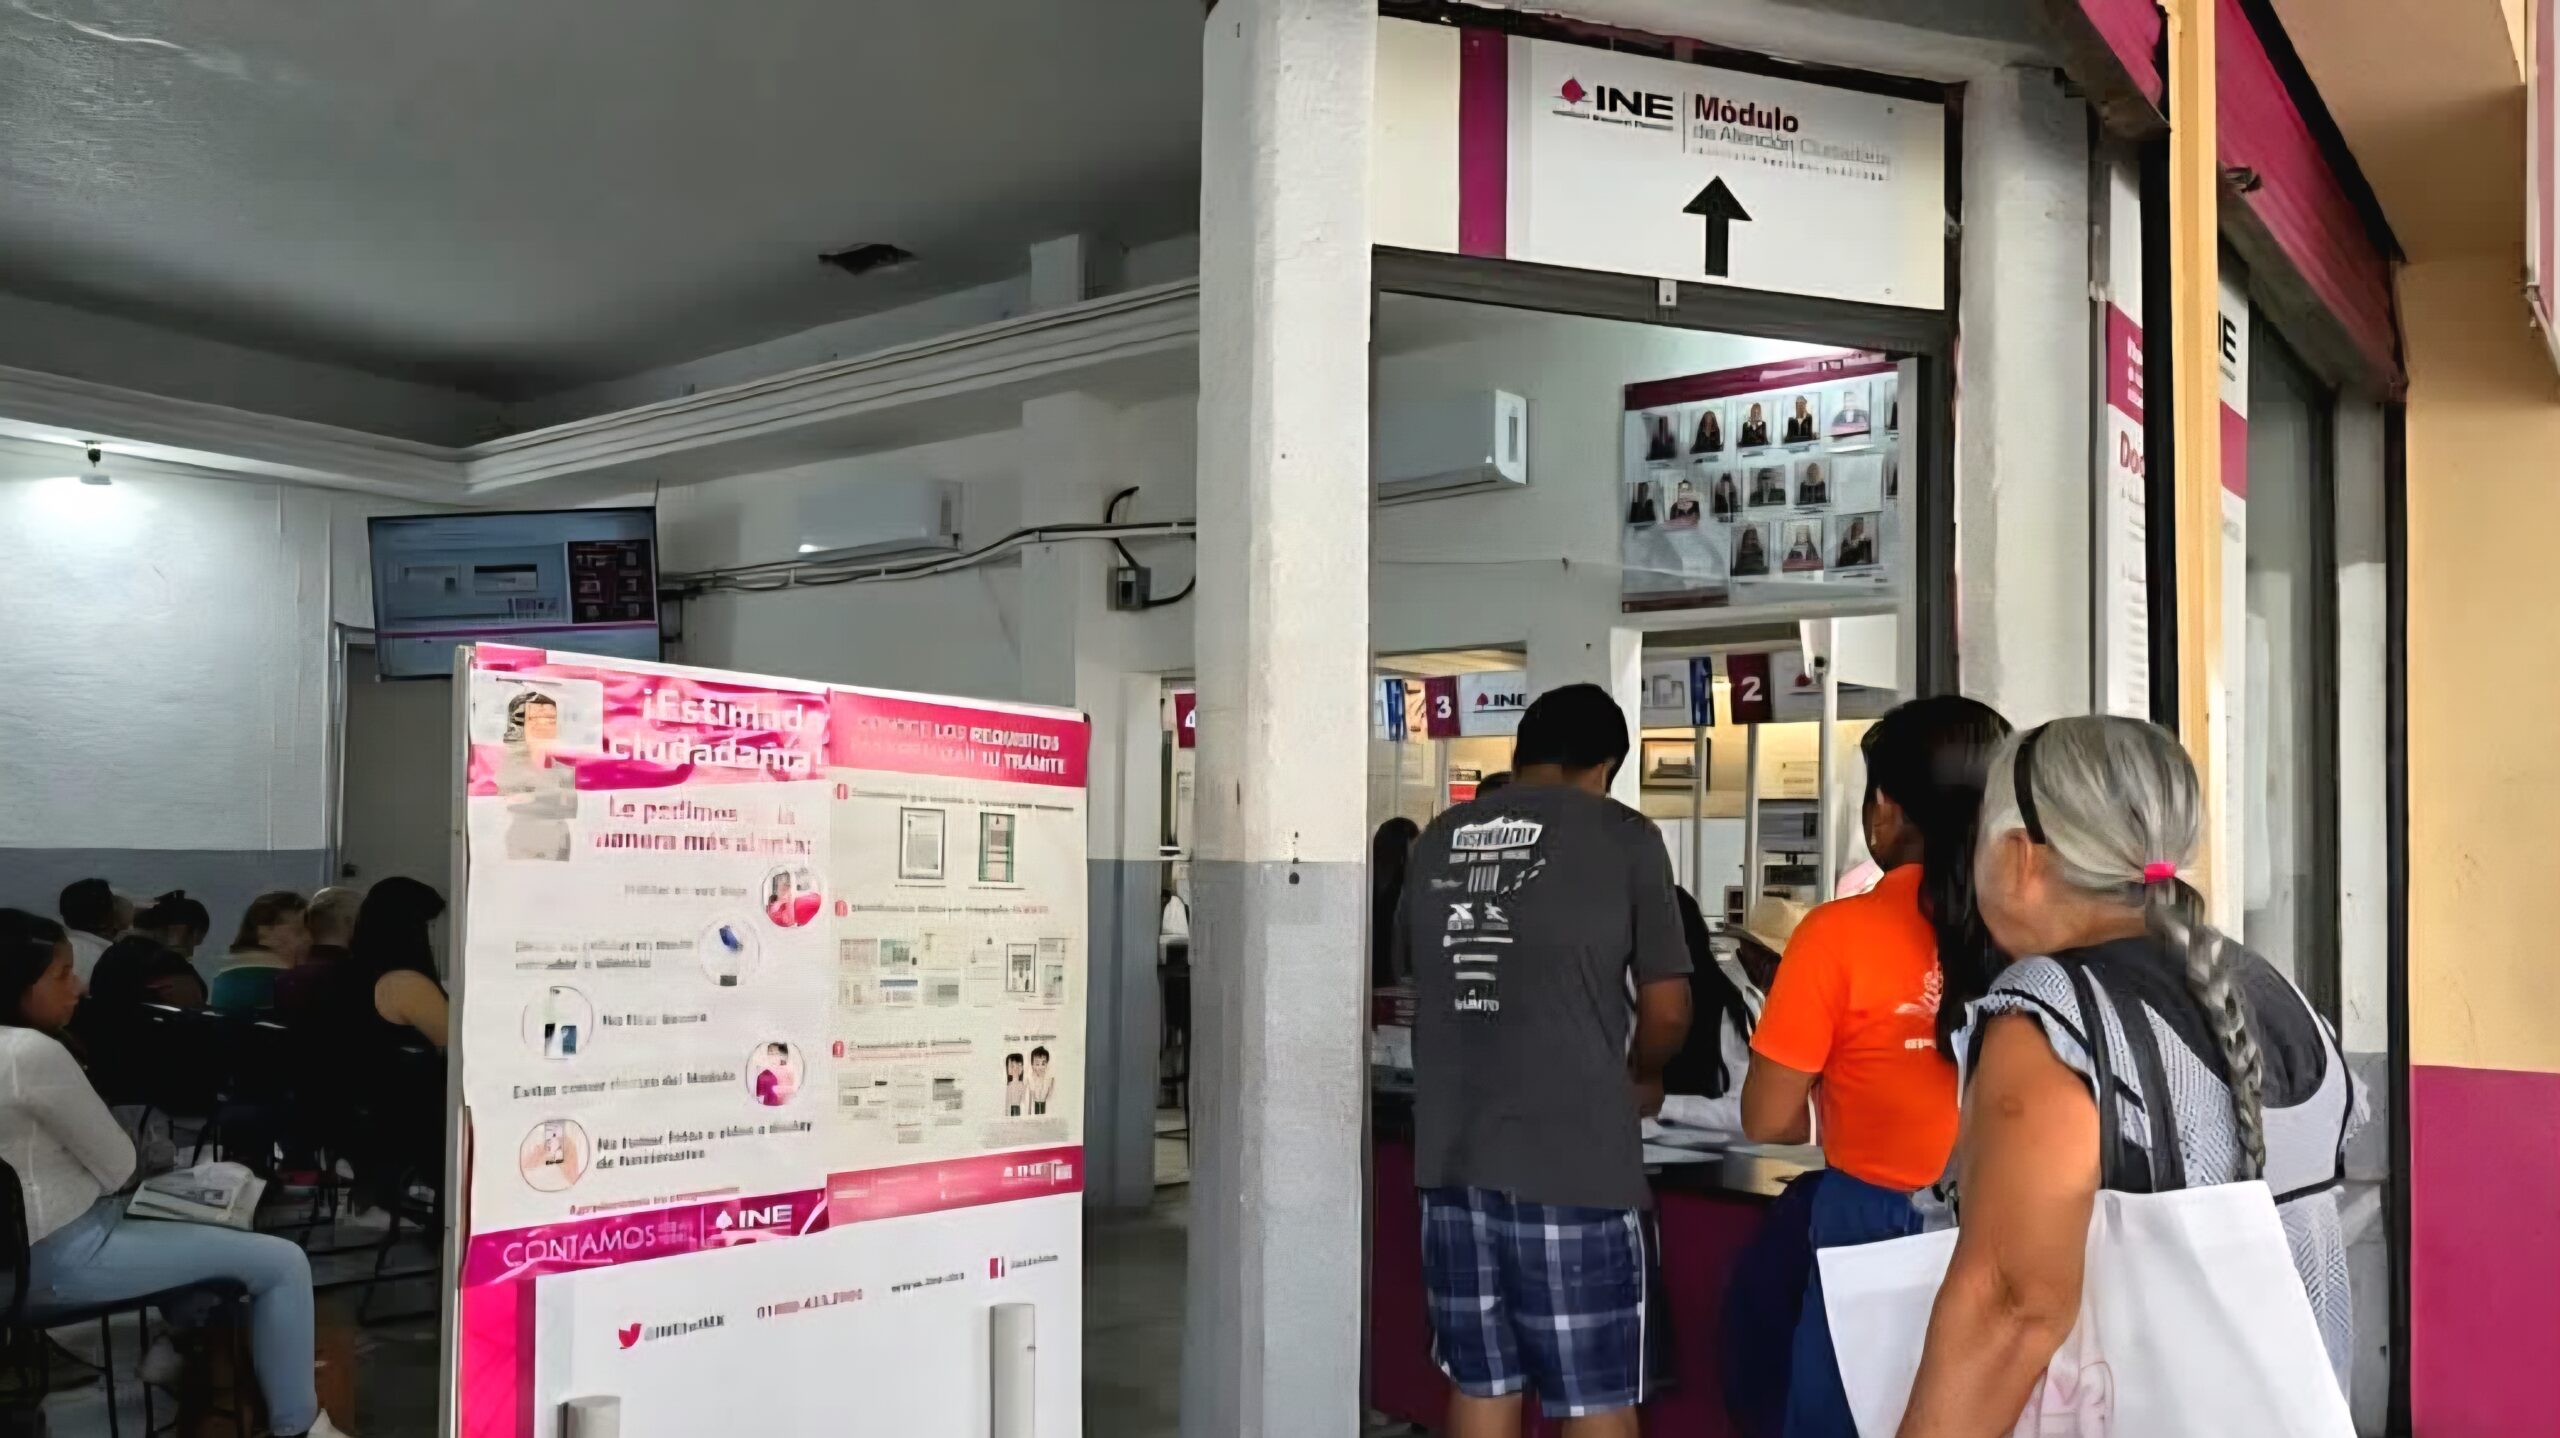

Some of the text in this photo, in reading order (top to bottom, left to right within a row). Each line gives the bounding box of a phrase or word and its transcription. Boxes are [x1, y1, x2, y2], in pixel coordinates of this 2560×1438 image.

[1596, 85, 1674, 120] INE
[1695, 93, 1799, 133] Módulo
[1742, 676, 1763, 702] 2
[1435, 695, 1452, 719] 3
[503, 1225, 655, 1268] CONTAMOS
[739, 1204, 793, 1229] INE
